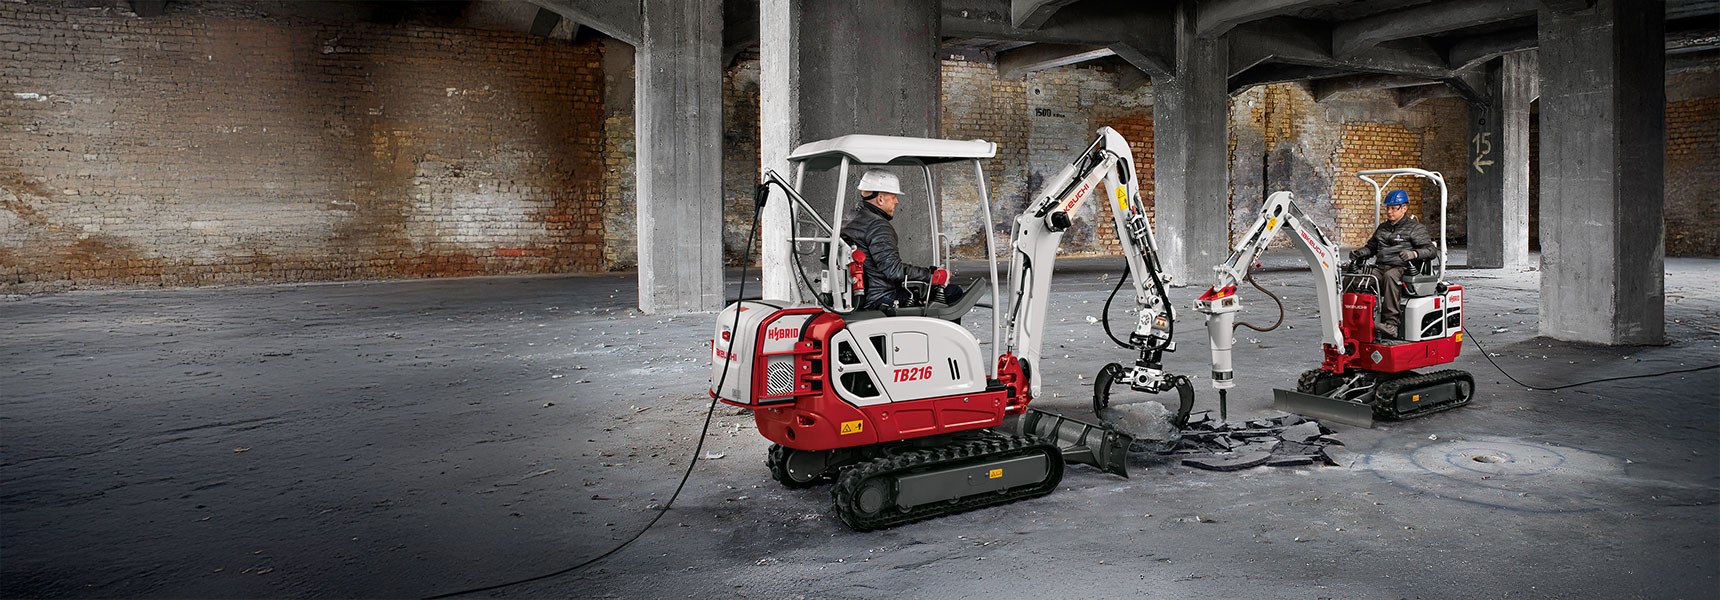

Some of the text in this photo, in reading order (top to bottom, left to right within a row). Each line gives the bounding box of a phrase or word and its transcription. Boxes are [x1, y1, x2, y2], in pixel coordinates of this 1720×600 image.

[1035, 108, 1051, 117] 1500
[1472, 132, 1491, 155] 15
[1063, 183, 1090, 213] KEUCHI
[1300, 229, 1326, 258] TAKEUCHI
[768, 327, 799, 341] HYBRID
[893, 365, 933, 383] TB216
